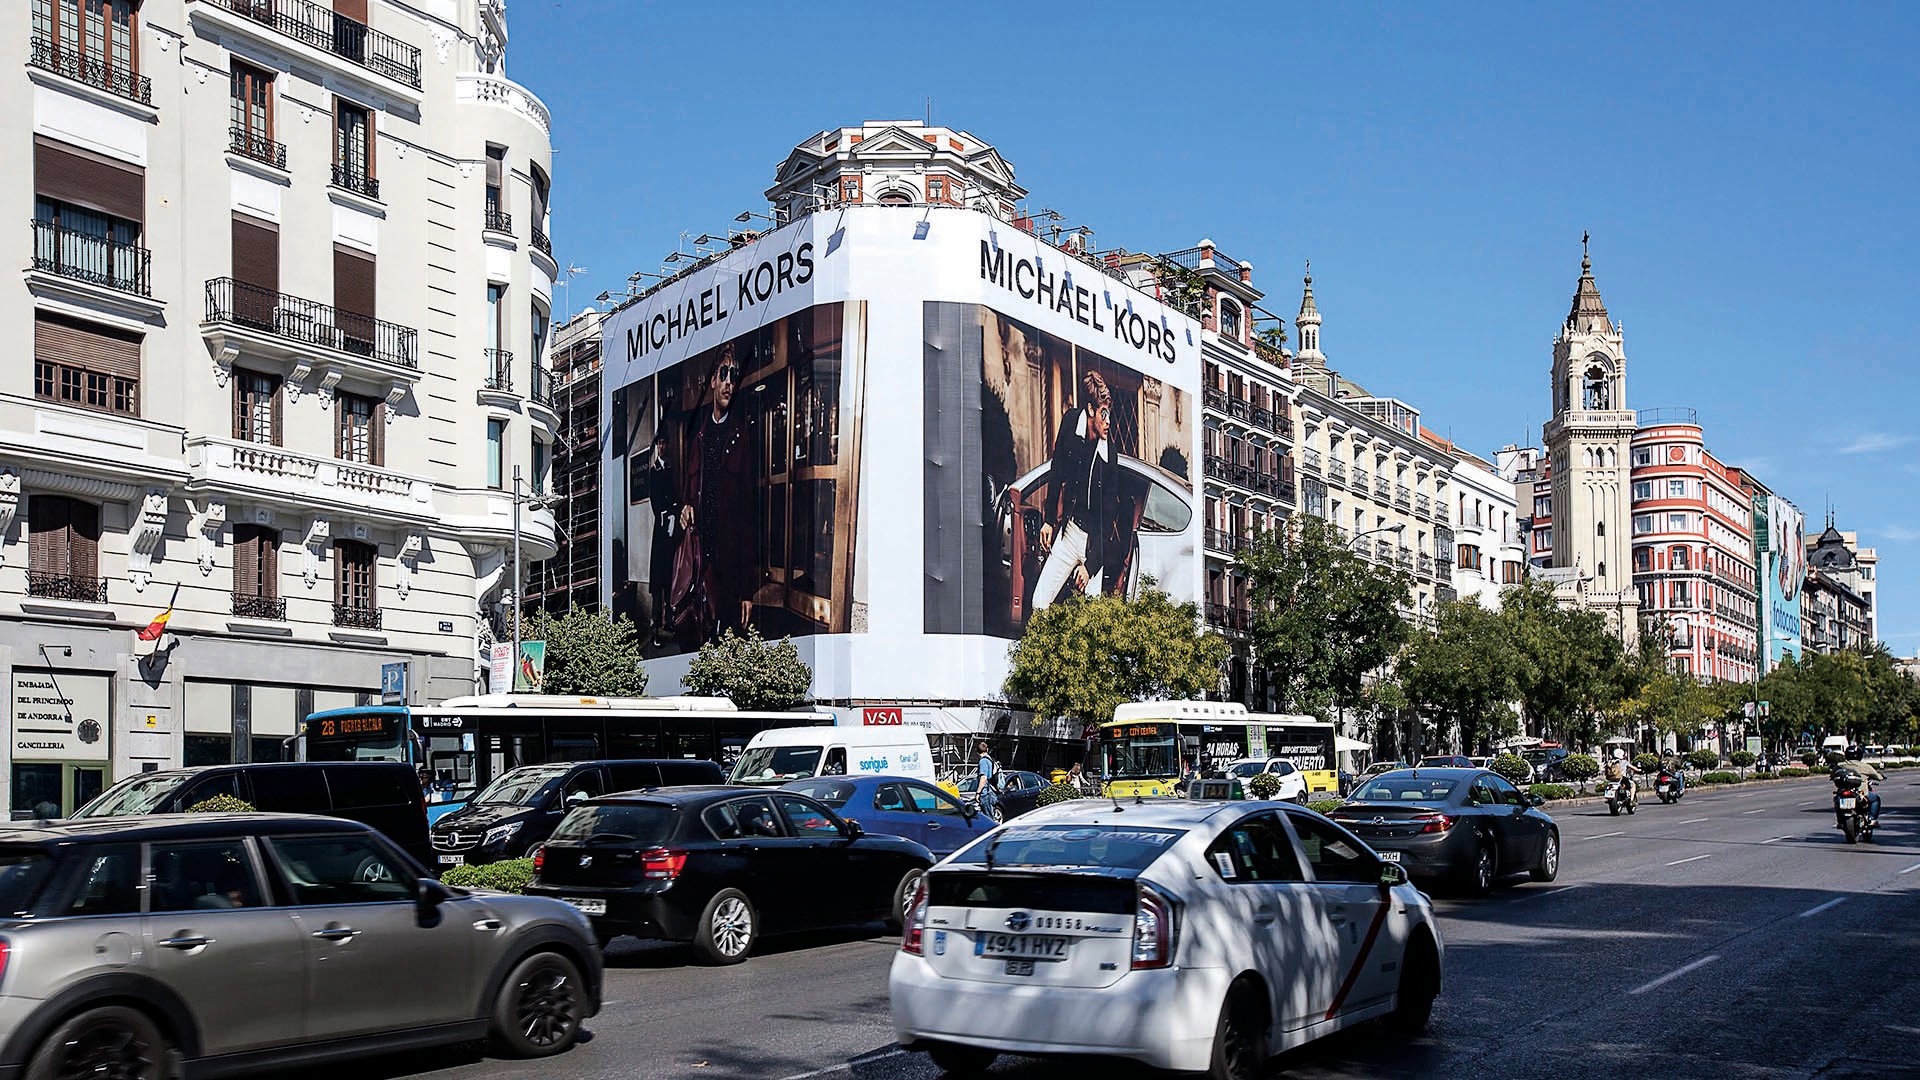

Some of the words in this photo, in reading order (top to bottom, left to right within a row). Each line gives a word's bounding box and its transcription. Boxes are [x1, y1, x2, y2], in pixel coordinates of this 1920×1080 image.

[627, 284, 728, 363] MICHAEL
[737, 242, 815, 312] KORS
[980, 240, 1105, 334] MICHAEL
[1114, 306, 1177, 366] KORS
[1773, 600, 1800, 636] fotocasa
[17, 680, 54, 689] EMBAJADA
[387, 670, 399, 693] P
[17, 696, 32, 704] DEL
[17, 712, 27, 720] DE
[28, 713, 63, 721] ANDORRA
[866, 712, 899, 724] VSA
[321, 720, 335, 736] 28
[1129, 728, 1140, 736] CITY
[17, 741, 65, 749] CANCILLERIA
[1215, 742, 1239, 756] HORAS
[1382, 852, 1398, 860] HXH
